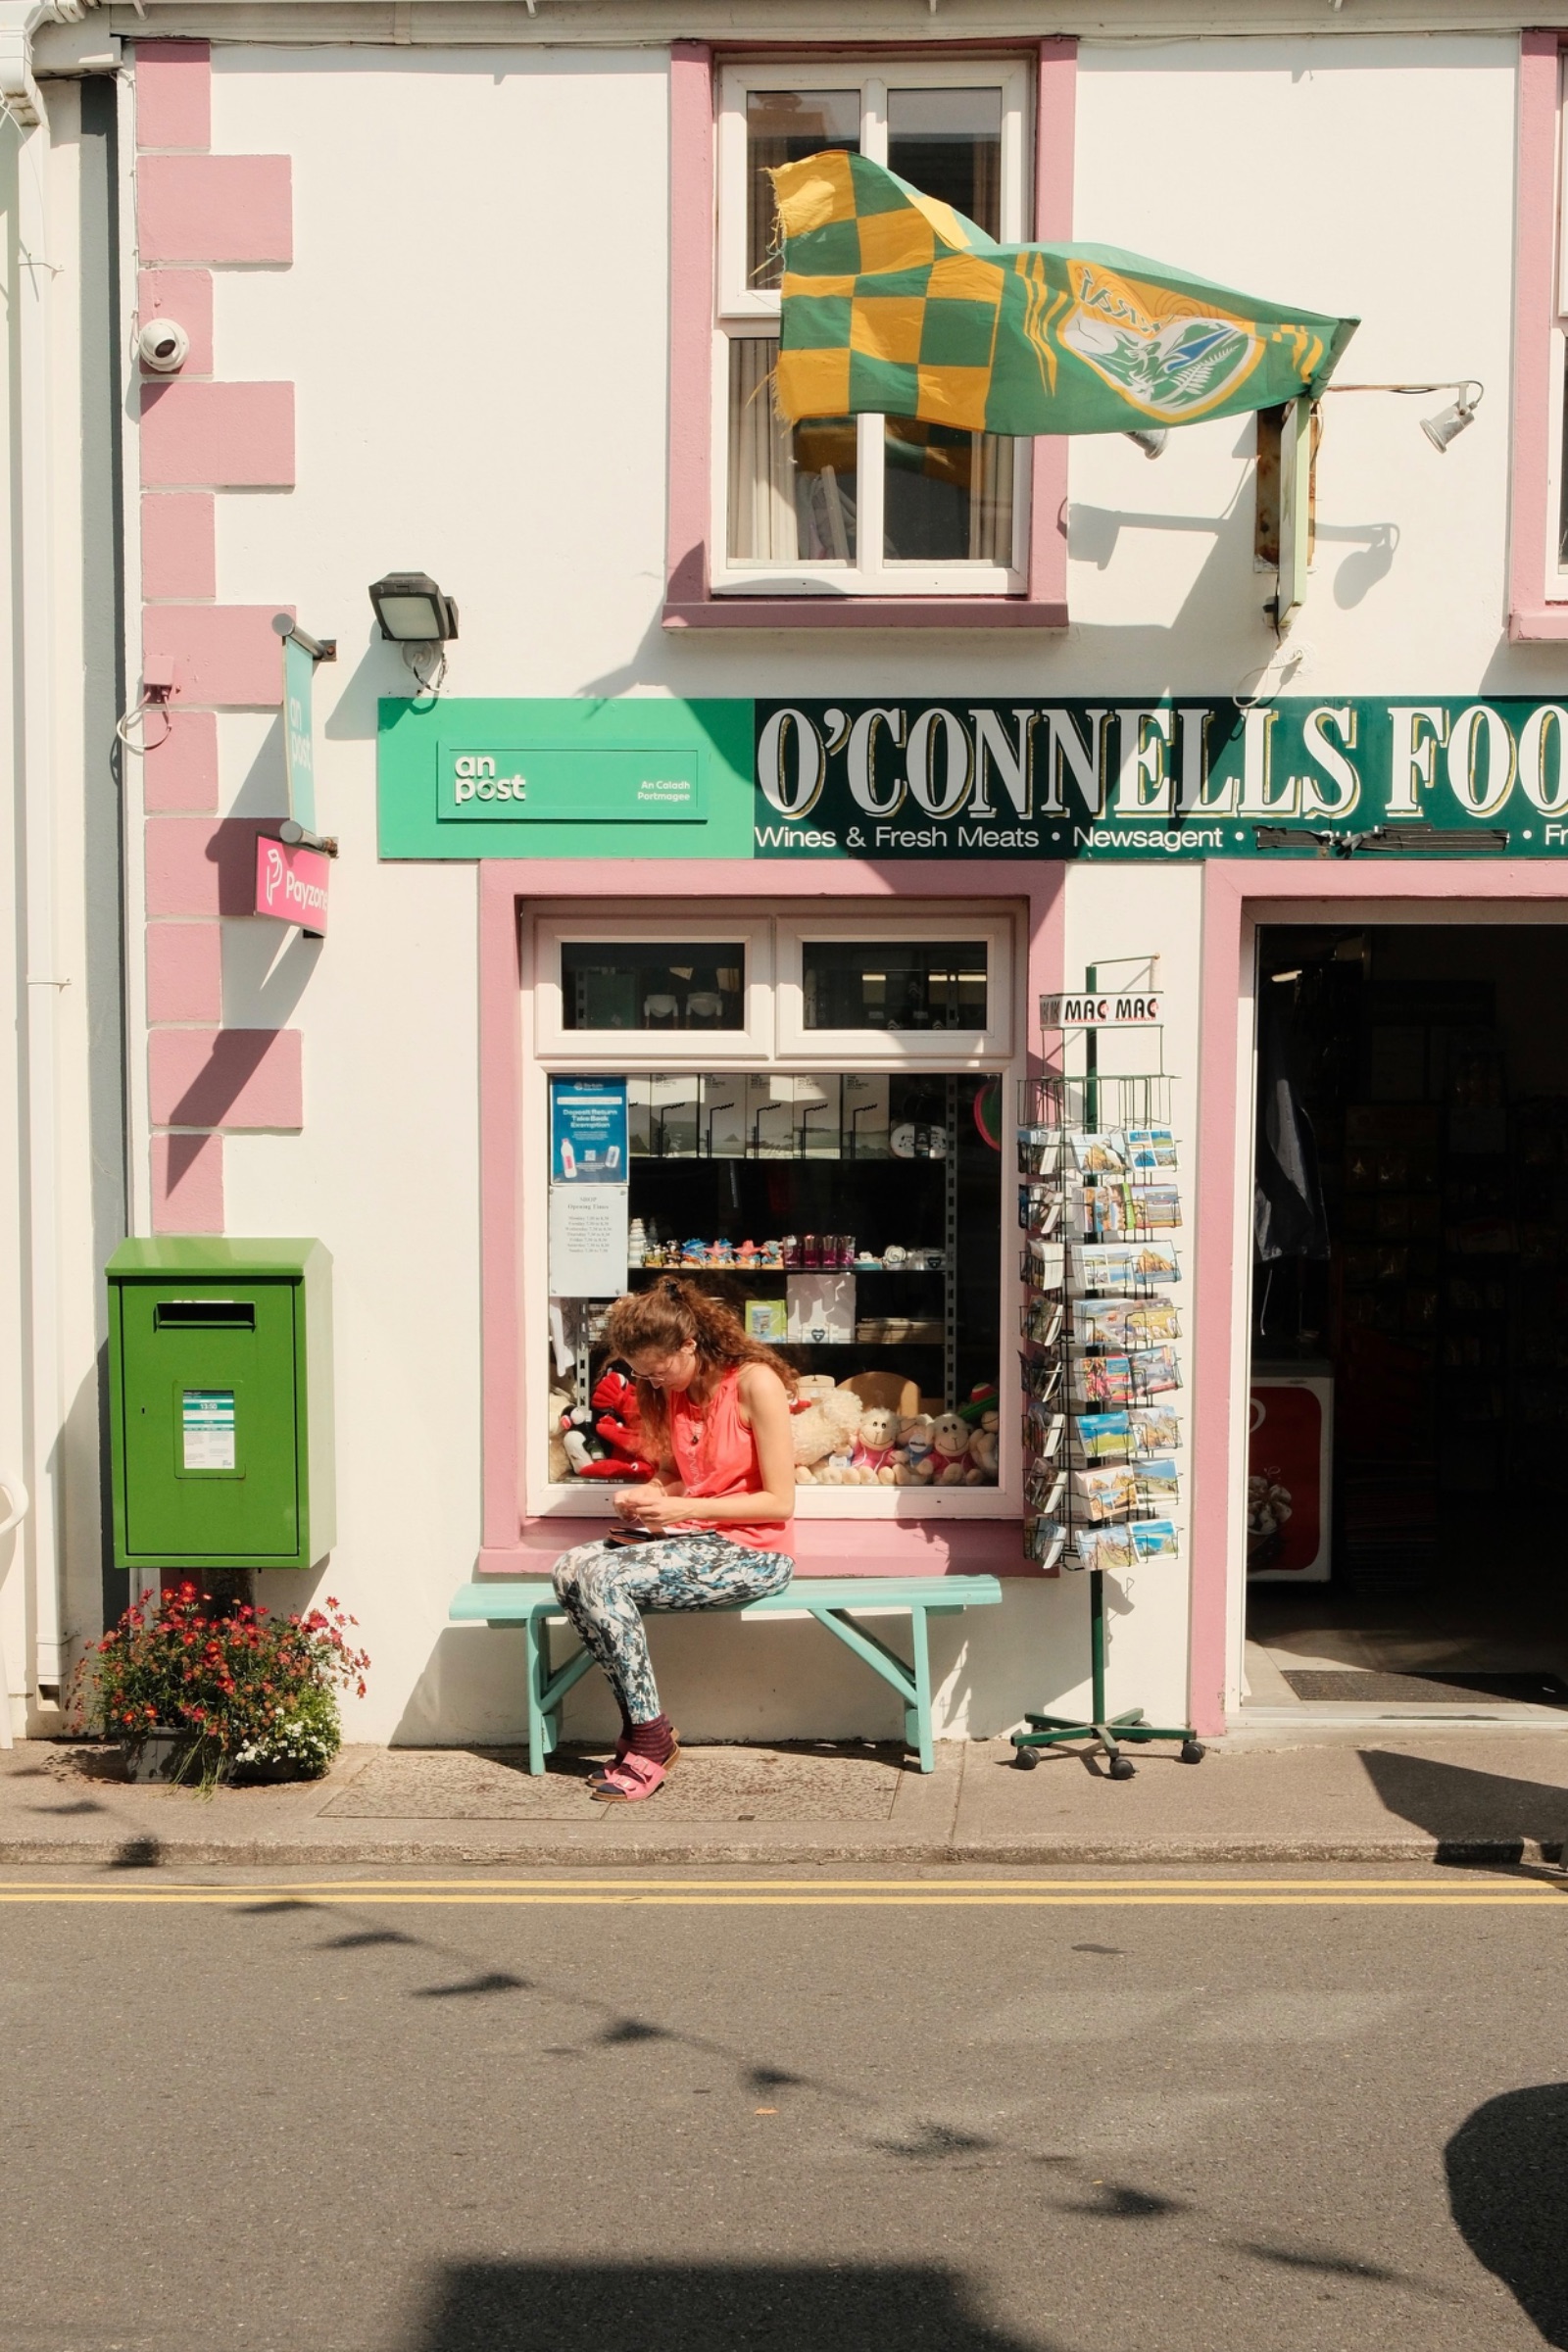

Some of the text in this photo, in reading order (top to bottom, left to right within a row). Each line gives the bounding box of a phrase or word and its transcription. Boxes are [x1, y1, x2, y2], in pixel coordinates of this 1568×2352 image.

[290, 697, 302, 732] an
[291, 730, 311, 771] post
[758, 706, 1360, 819] O'CONNELLS
[455, 757, 495, 777] an
[455, 774, 526, 805] post
[637, 792, 691, 803] Portmagee
[641, 781, 655, 790] An
[755, 825, 1039, 848] Wines & Fresh Meats
[1073, 825, 1223, 852] Newsagent
[286, 869, 328, 912] Payzone
[1064, 1000, 1107, 1020] MAC
[1115, 998, 1156, 1019] MAC
